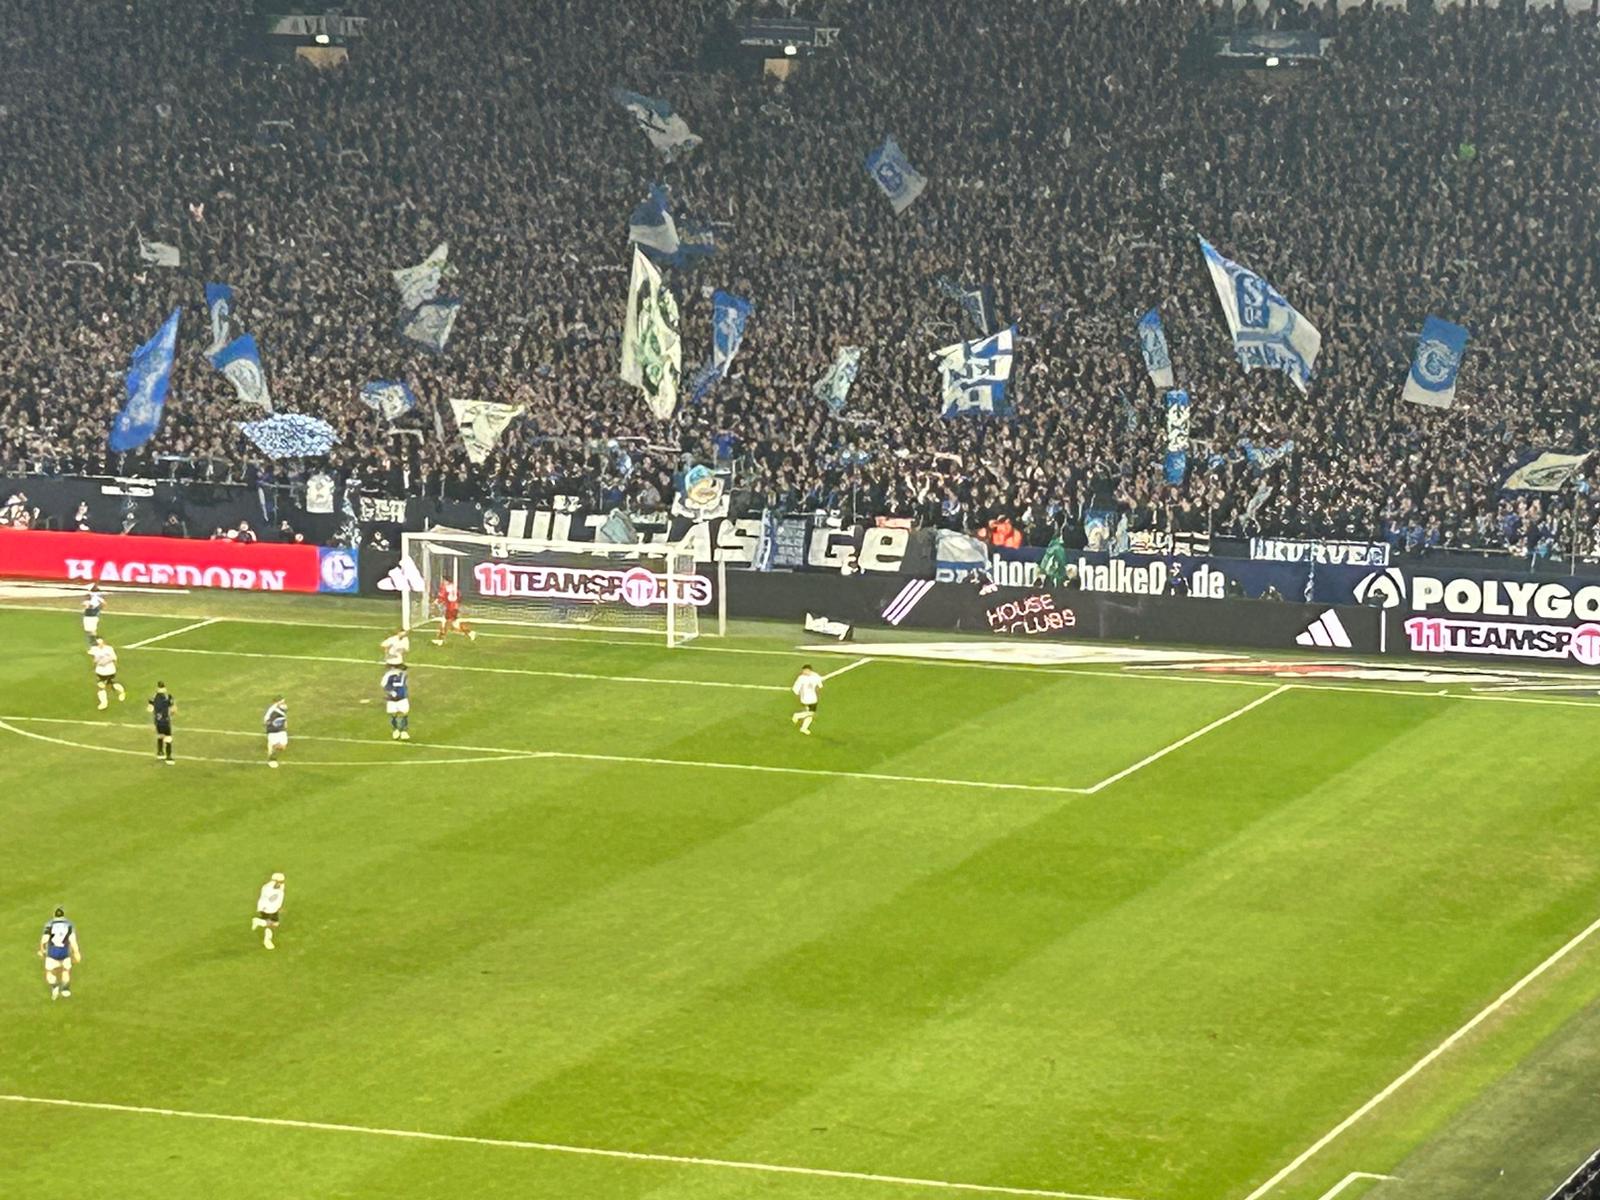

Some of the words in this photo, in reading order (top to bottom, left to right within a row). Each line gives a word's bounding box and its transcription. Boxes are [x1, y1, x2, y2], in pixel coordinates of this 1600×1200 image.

[65, 558, 286, 590] HAGEDORN
[986, 594, 1055, 626] HOUSE
[1412, 577, 1600, 621] POLYGO
